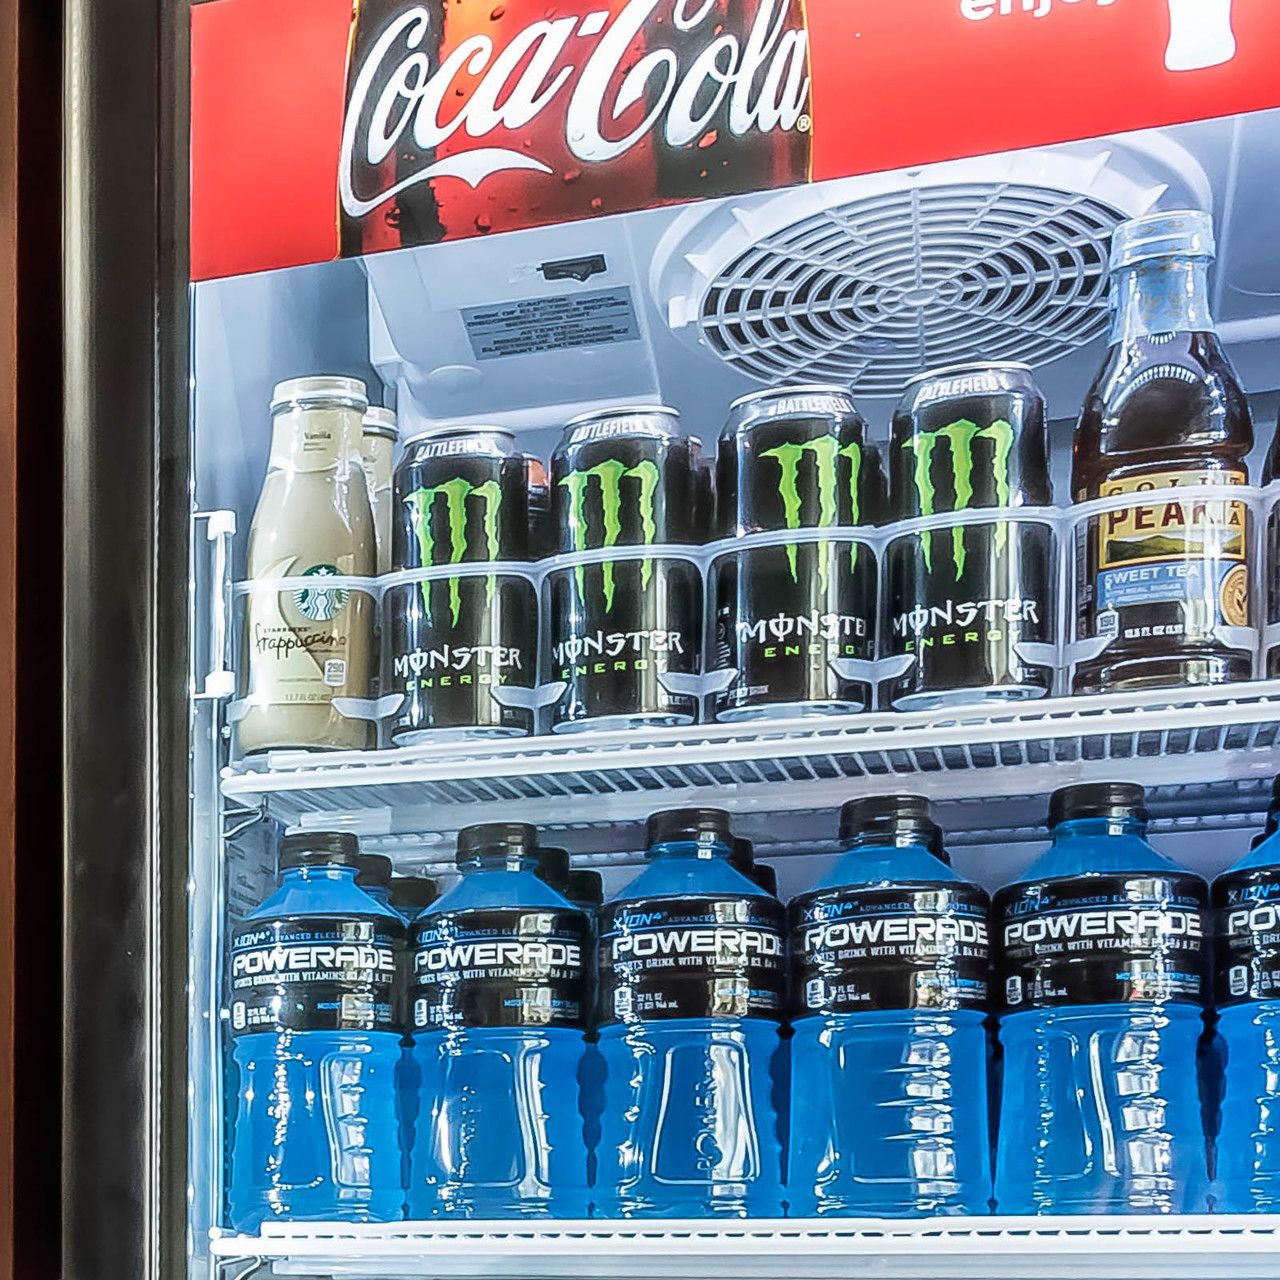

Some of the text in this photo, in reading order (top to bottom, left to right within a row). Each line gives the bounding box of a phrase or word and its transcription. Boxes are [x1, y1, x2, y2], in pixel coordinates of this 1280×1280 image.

[341, 0, 811, 215] Coca-Cola
[1105, 565, 1199, 584] SWEET TEA
[893, 599, 1040, 638] MONSTER
[393, 644, 522, 679] MONSTER
[552, 629, 684, 665] MONSTER
[805, 917, 989, 951] POWERADE
[1004, 911, 1203, 946] POWERADE
[233, 945, 395, 977] POWERADE
[414, 943, 581, 973] POWERADE
[463, 970, 485, 979] WITH
[678, 956, 703, 965] WITH
